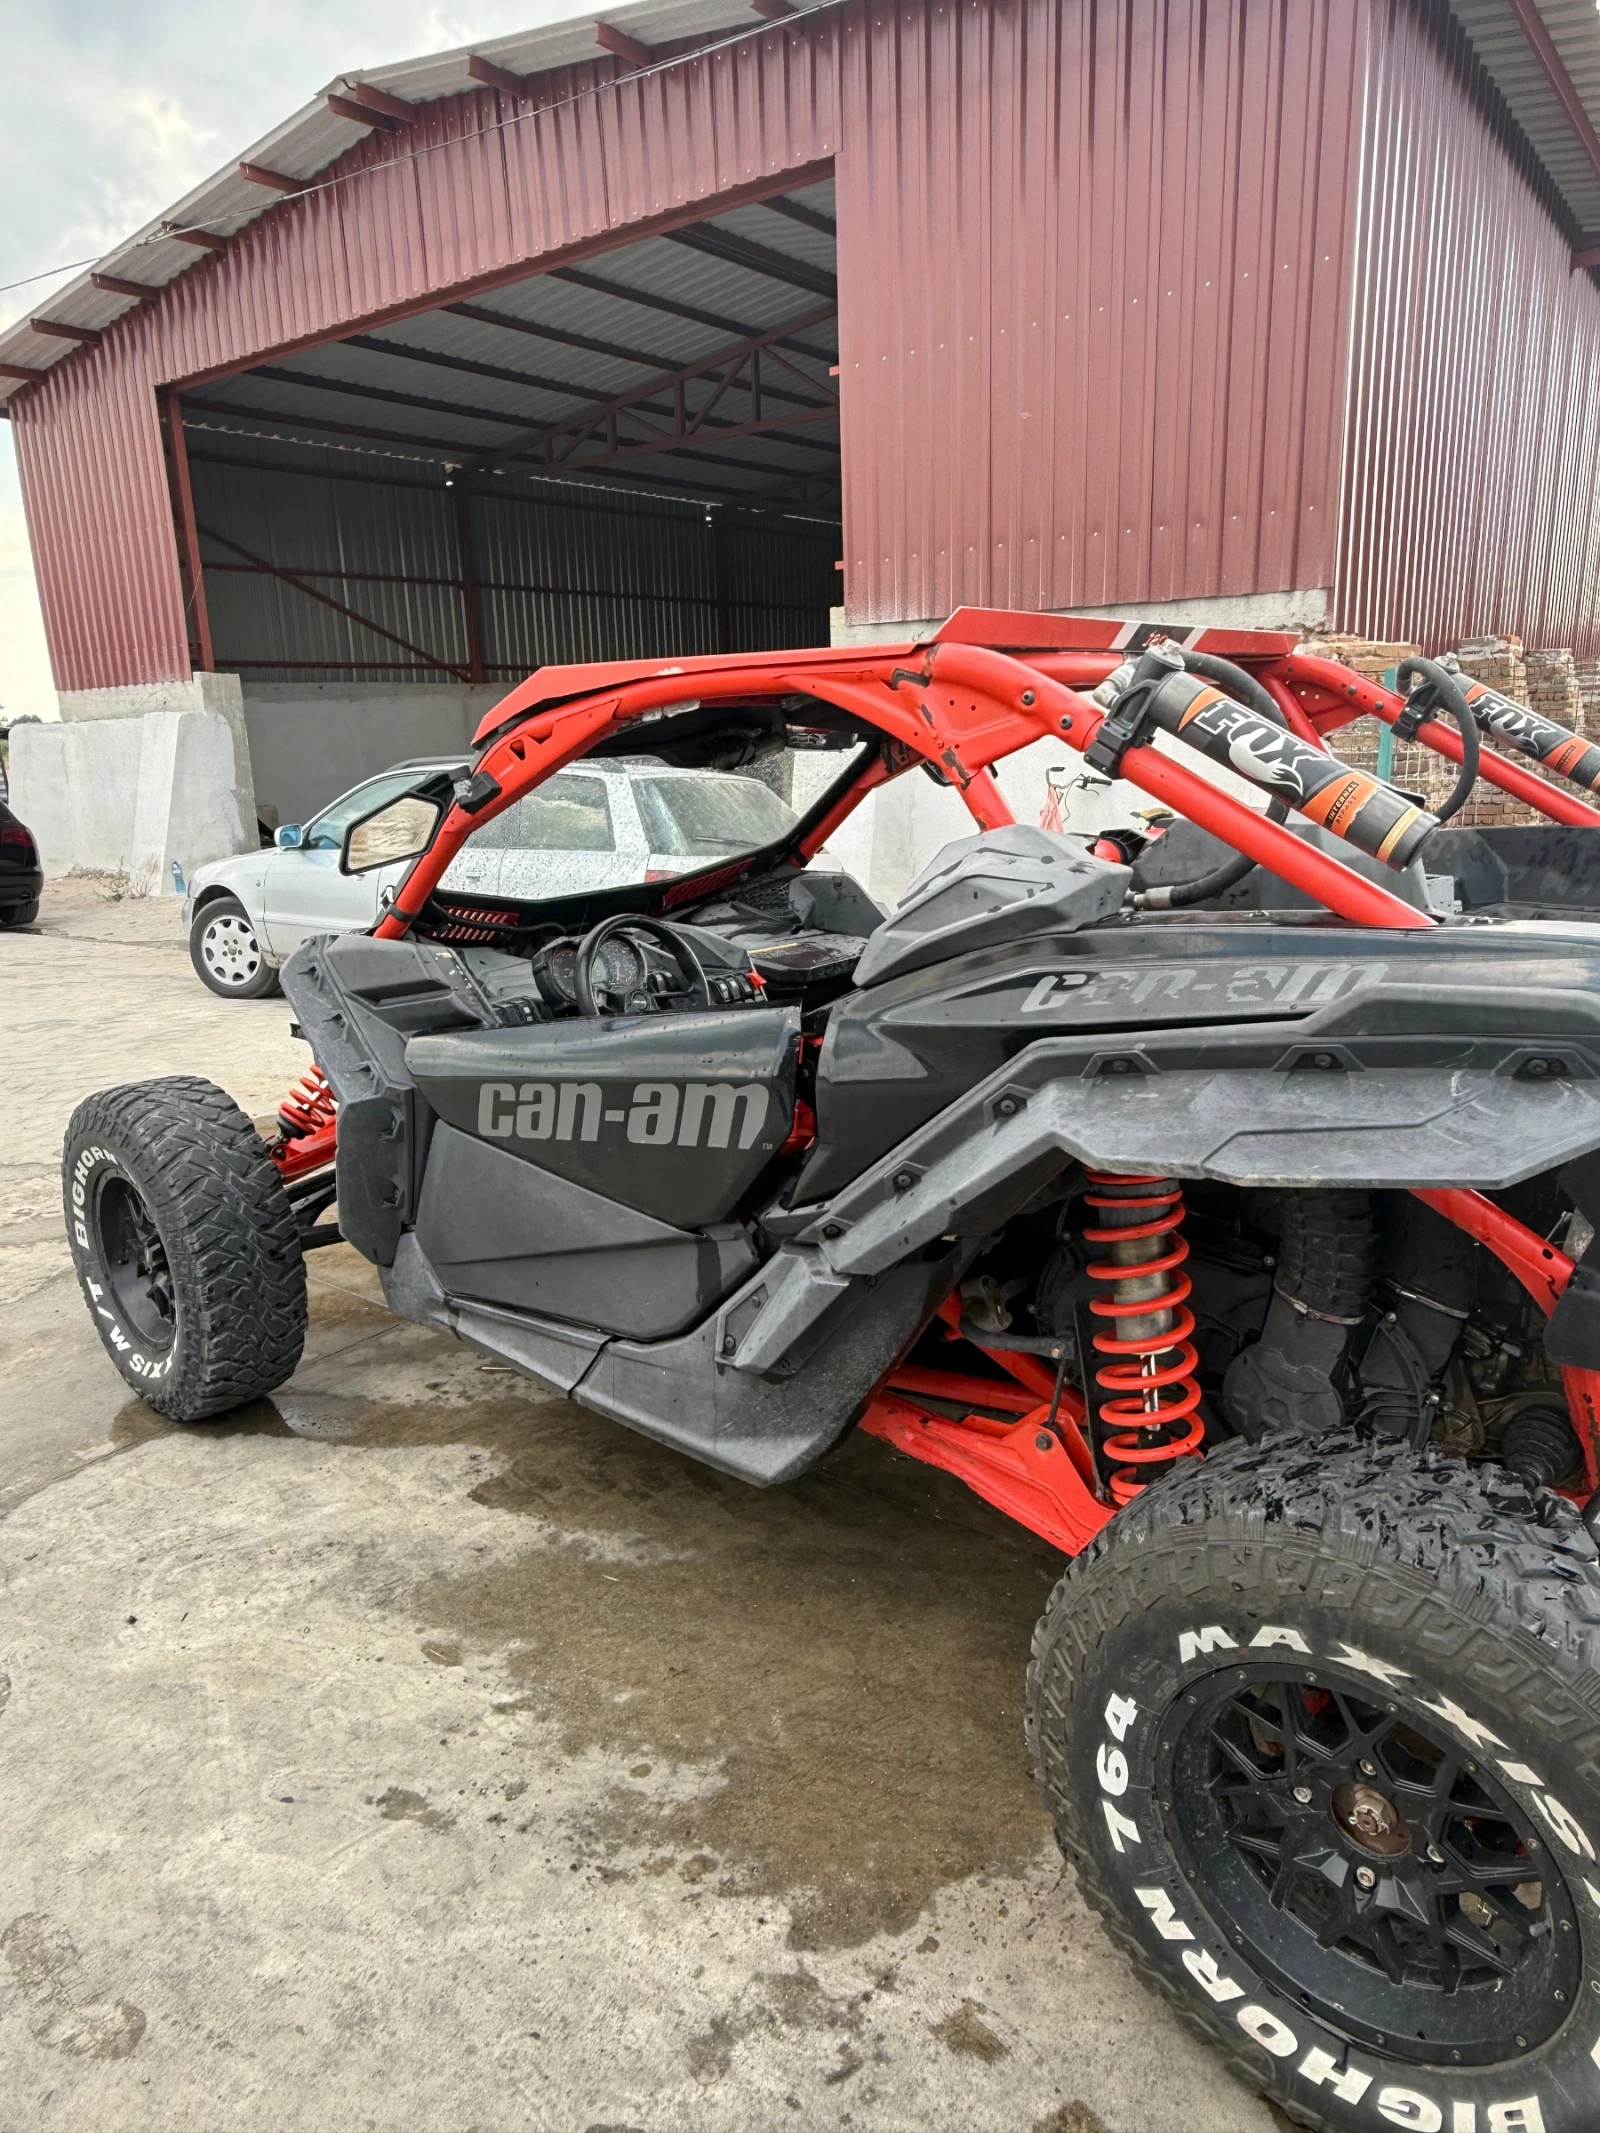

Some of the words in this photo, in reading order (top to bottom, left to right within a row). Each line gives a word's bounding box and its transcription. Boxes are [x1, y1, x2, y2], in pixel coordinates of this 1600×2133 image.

[1193, 699, 1331, 796] FOX
[1469, 692, 1557, 756] FOX
[1327, 781, 1358, 821] INTERNAL
[477, 1082, 770, 1150] can-am
[72, 1146, 119, 1250] BIGHORN
[1096, 1692, 1143, 1854] 764
[1178, 1625, 1597, 1862] MAXXIS
[1133, 1887, 1547, 2133] BIGHORN
